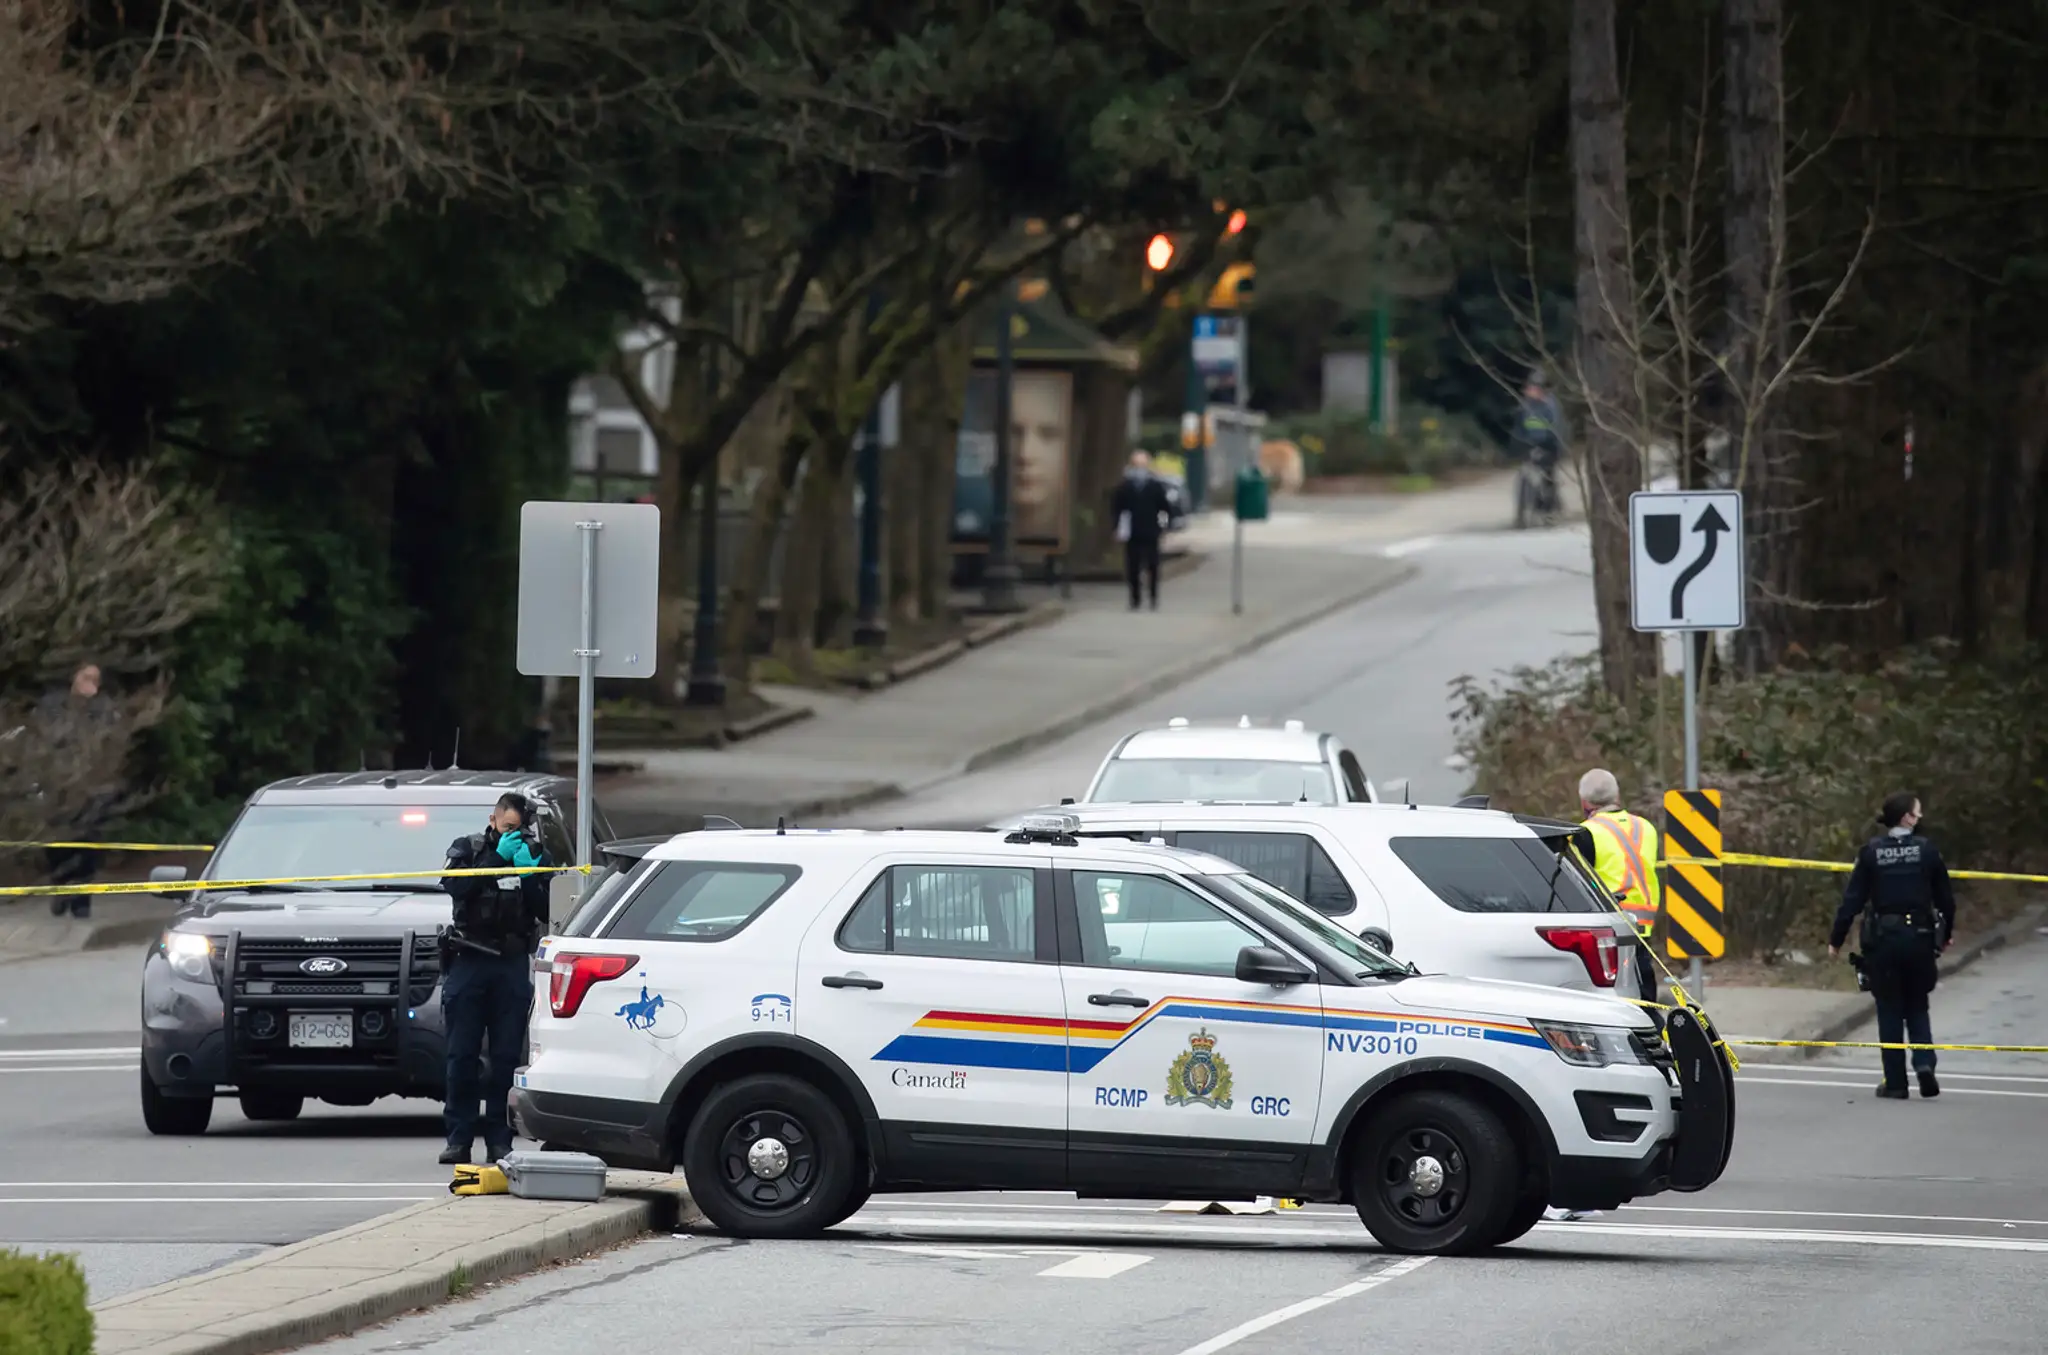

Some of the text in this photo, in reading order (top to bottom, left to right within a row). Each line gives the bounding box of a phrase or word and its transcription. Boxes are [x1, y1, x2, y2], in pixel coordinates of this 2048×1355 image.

[1875, 846, 1920, 859] POLICE
[309, 959, 336, 972] Ford
[751, 1008, 791, 1022] 9-1-1
[1398, 1021, 1482, 1038] POLICE
[1327, 1032, 1418, 1055] NV3010
[892, 1068, 966, 1091] Canada
[1094, 1086, 1149, 1109] RCMP
[1250, 1095, 1291, 1117] GRC
